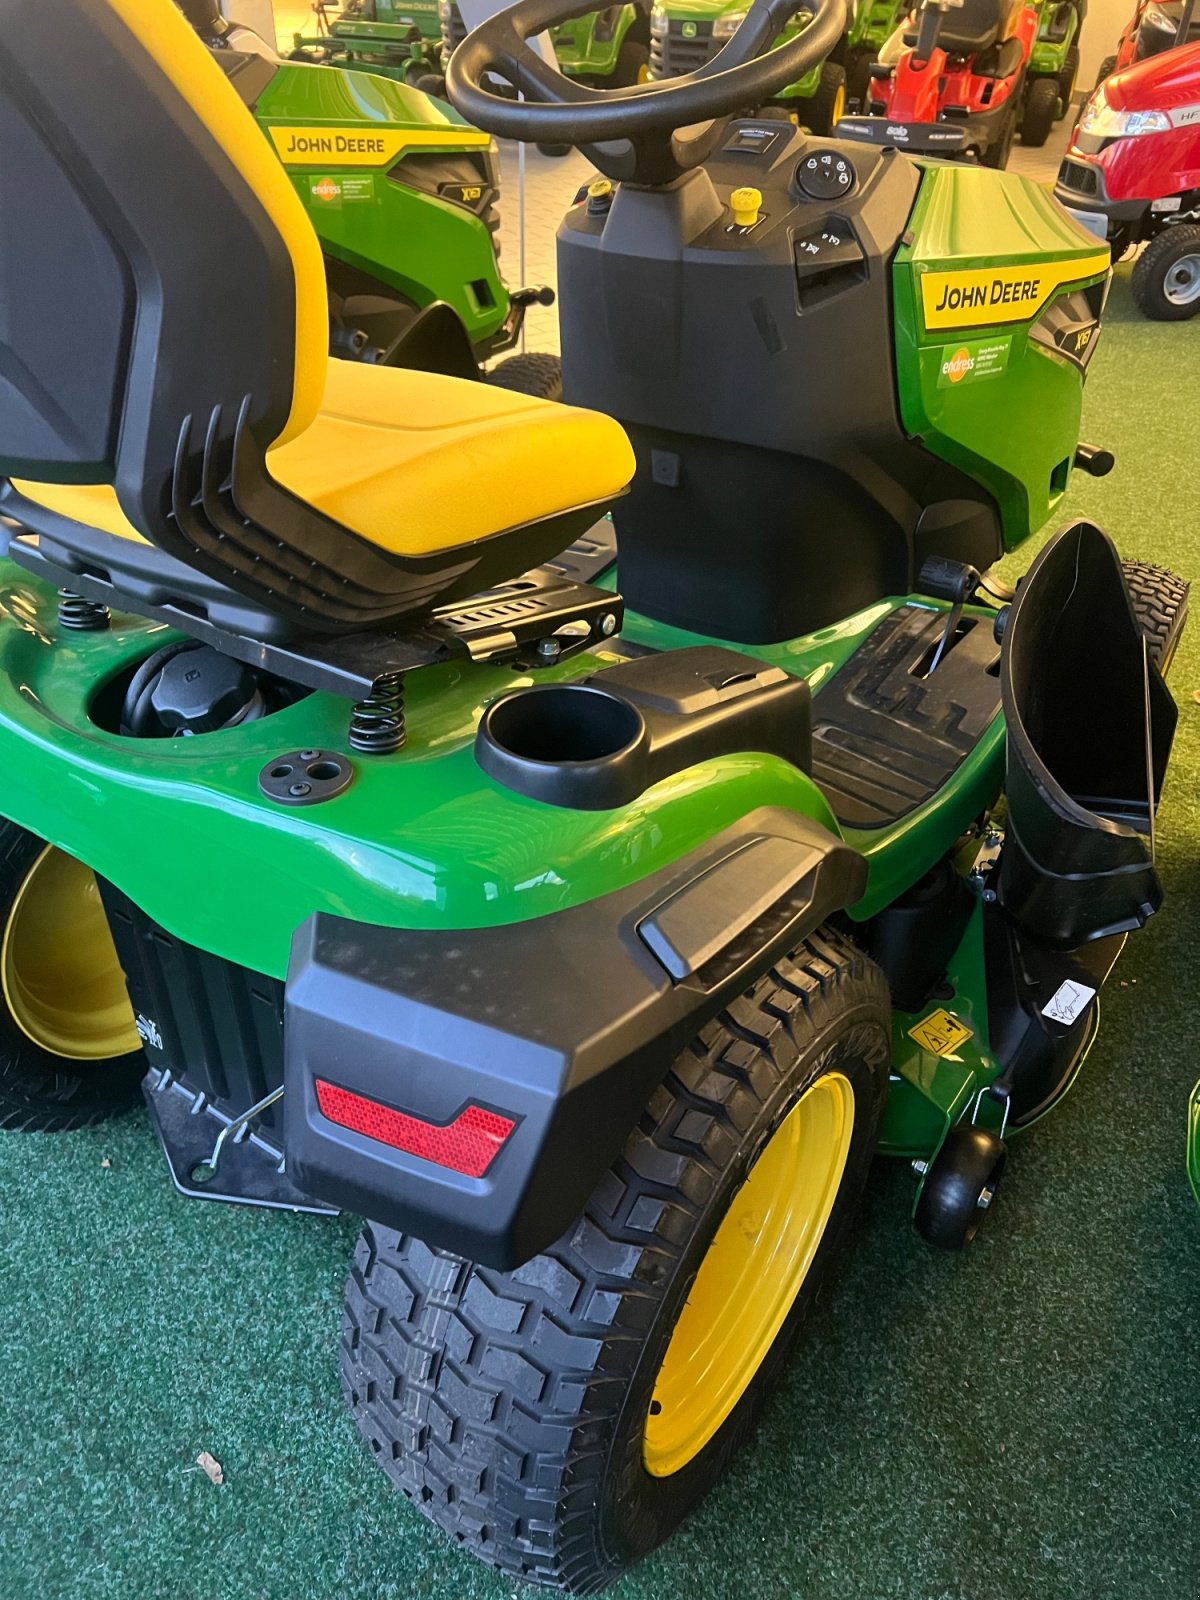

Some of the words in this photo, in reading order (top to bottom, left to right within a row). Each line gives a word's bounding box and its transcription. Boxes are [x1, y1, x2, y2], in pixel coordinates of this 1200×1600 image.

[287, 135, 333, 153] JOHN
[336, 135, 385, 153] DEERE
[311, 183, 342, 195] endress
[936, 284, 988, 312] JOHN
[989, 279, 1041, 305] DEERE
[942, 356, 975, 375] endress
